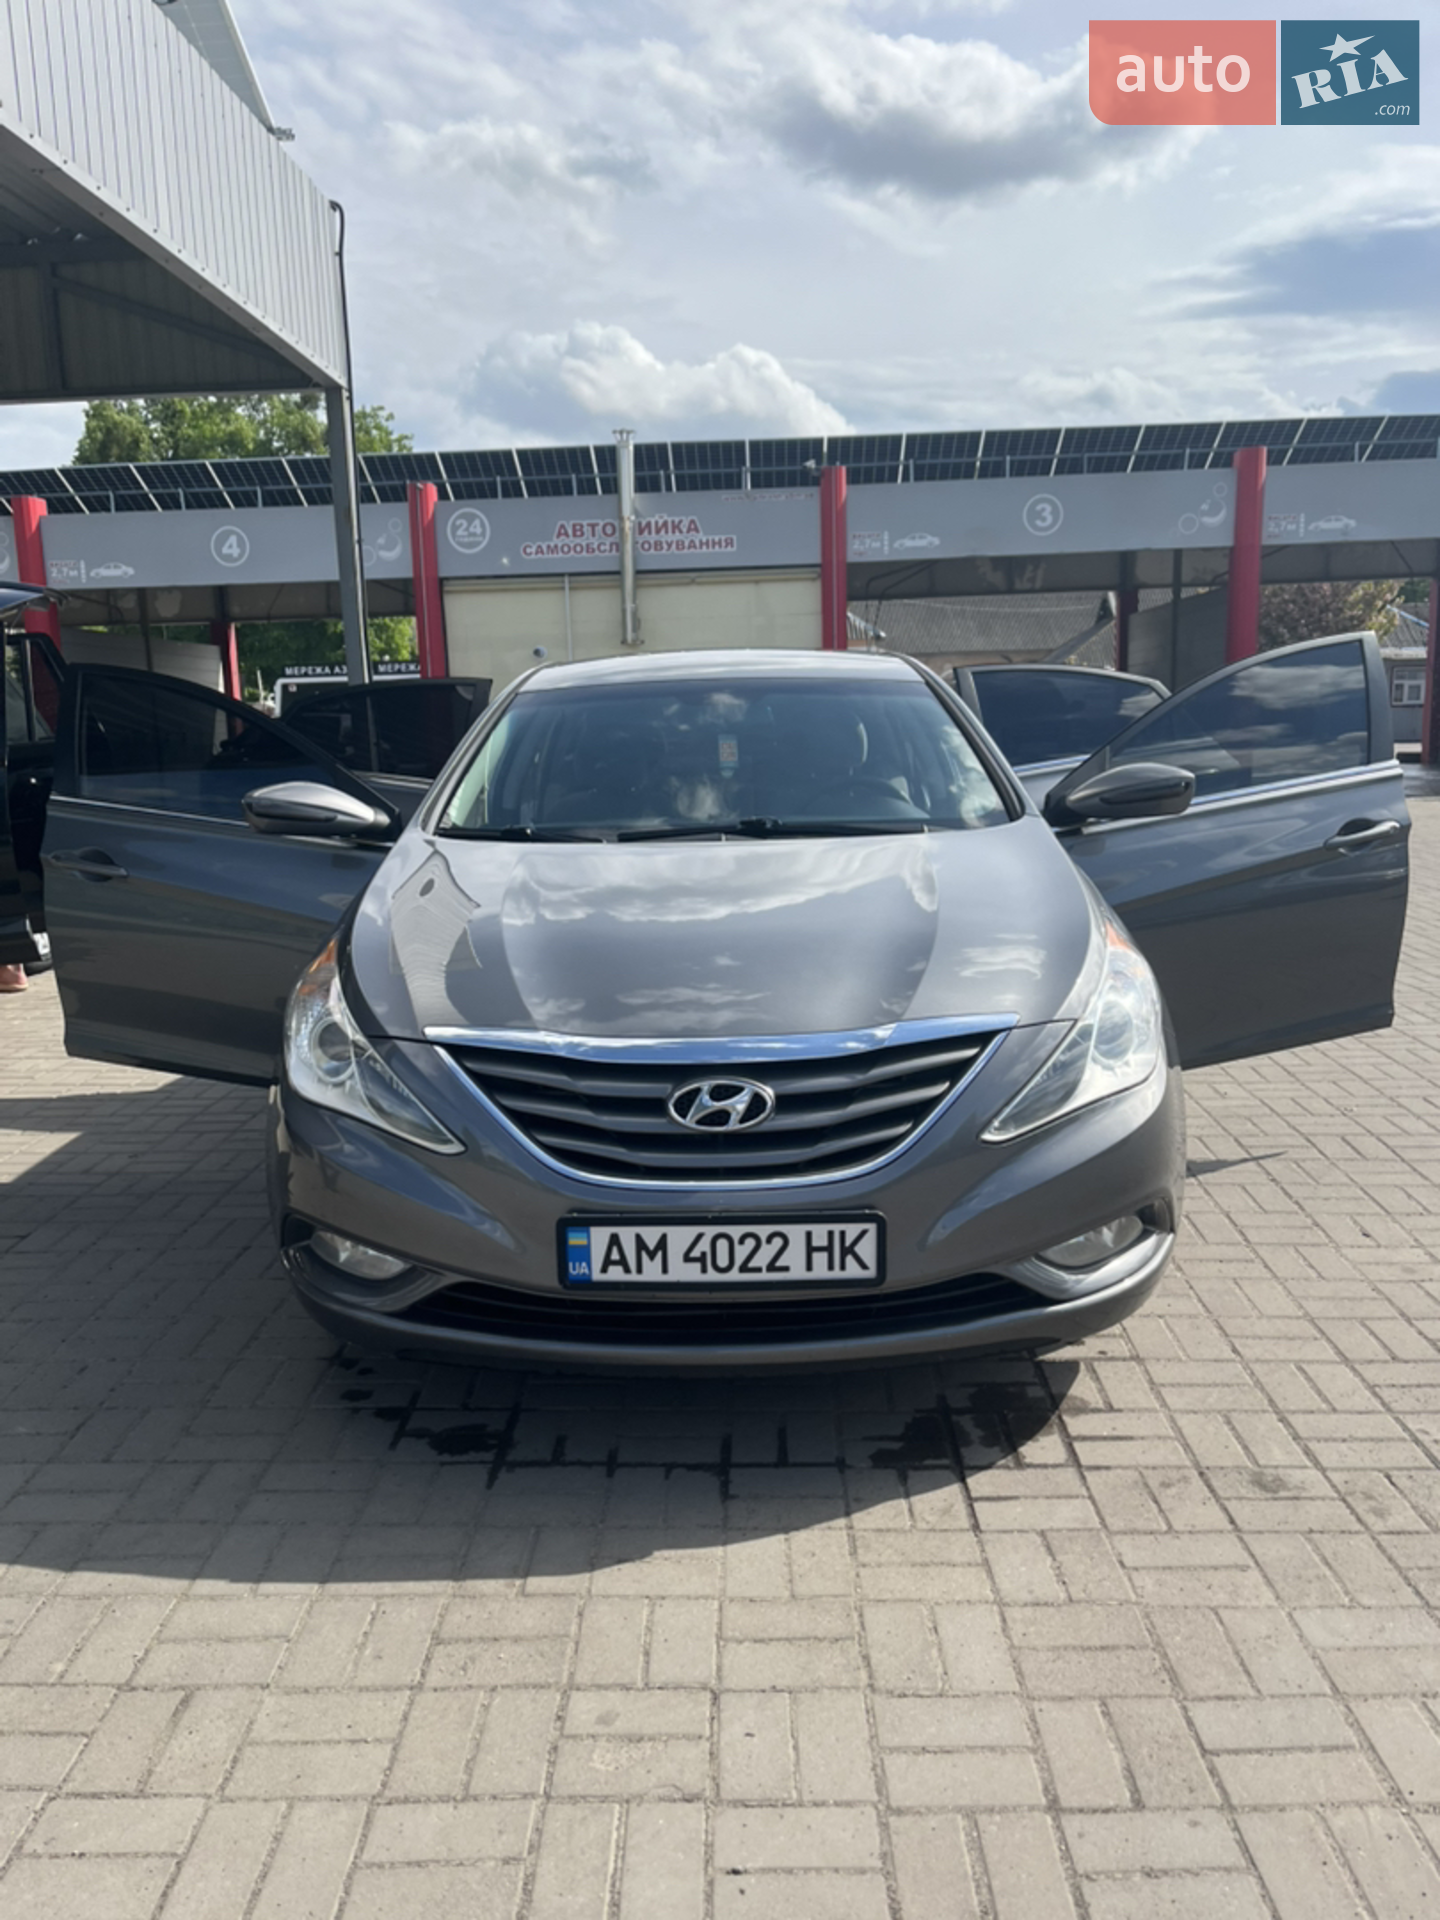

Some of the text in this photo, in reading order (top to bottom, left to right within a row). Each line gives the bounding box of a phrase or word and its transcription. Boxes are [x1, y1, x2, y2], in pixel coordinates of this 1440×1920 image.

[455, 518, 483, 536] 24
[1035, 503, 1053, 527] 3
[555, 515, 701, 540] АВТОИЙКА
[222, 534, 241, 558] 4
[284, 665, 331, 676] МЕРЕЖА
[600, 1228, 871, 1275] AM 4022 HK
[569, 1261, 590, 1275] UA
